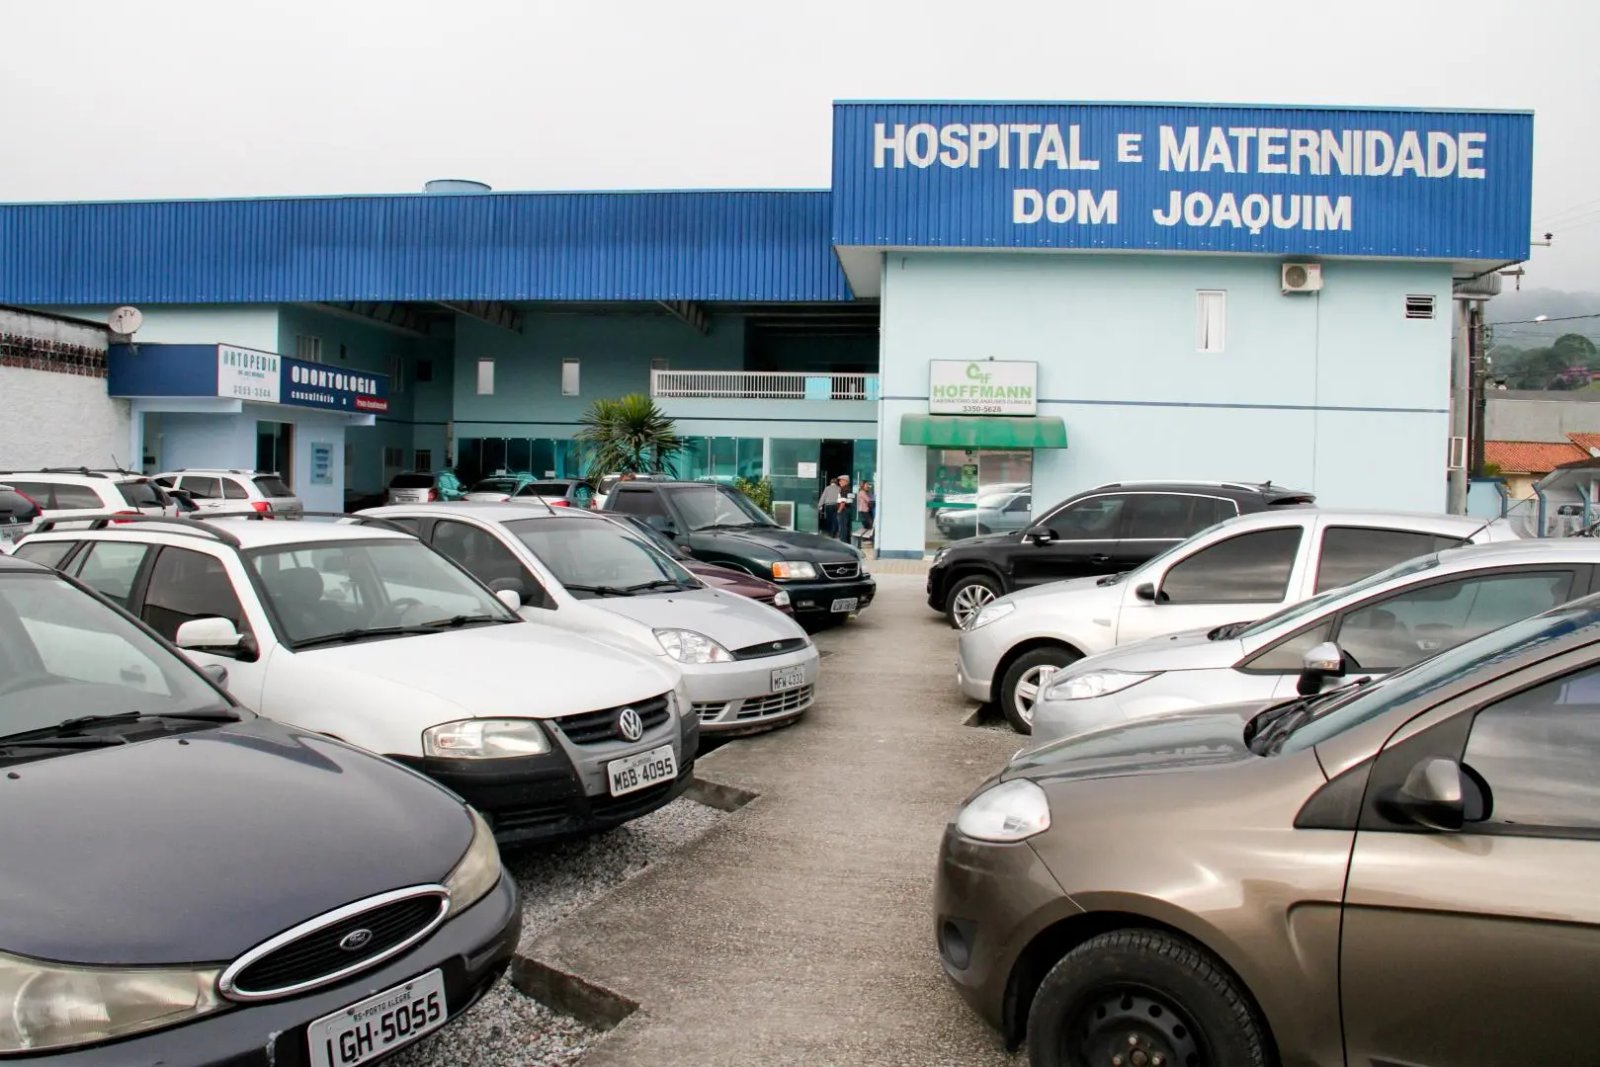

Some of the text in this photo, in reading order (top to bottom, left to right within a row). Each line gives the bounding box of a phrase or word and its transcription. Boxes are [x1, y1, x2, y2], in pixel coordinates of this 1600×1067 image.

[873, 122, 1487, 179] HOSPITAL E MATERNIDADE
[1012, 188, 1352, 235] DOM JOAQUIM
[223, 350, 277, 372] ORTOPEDIA
[291, 365, 377, 395] ODONTOLOGIA
[932, 385, 1033, 399] HOFFMANN
